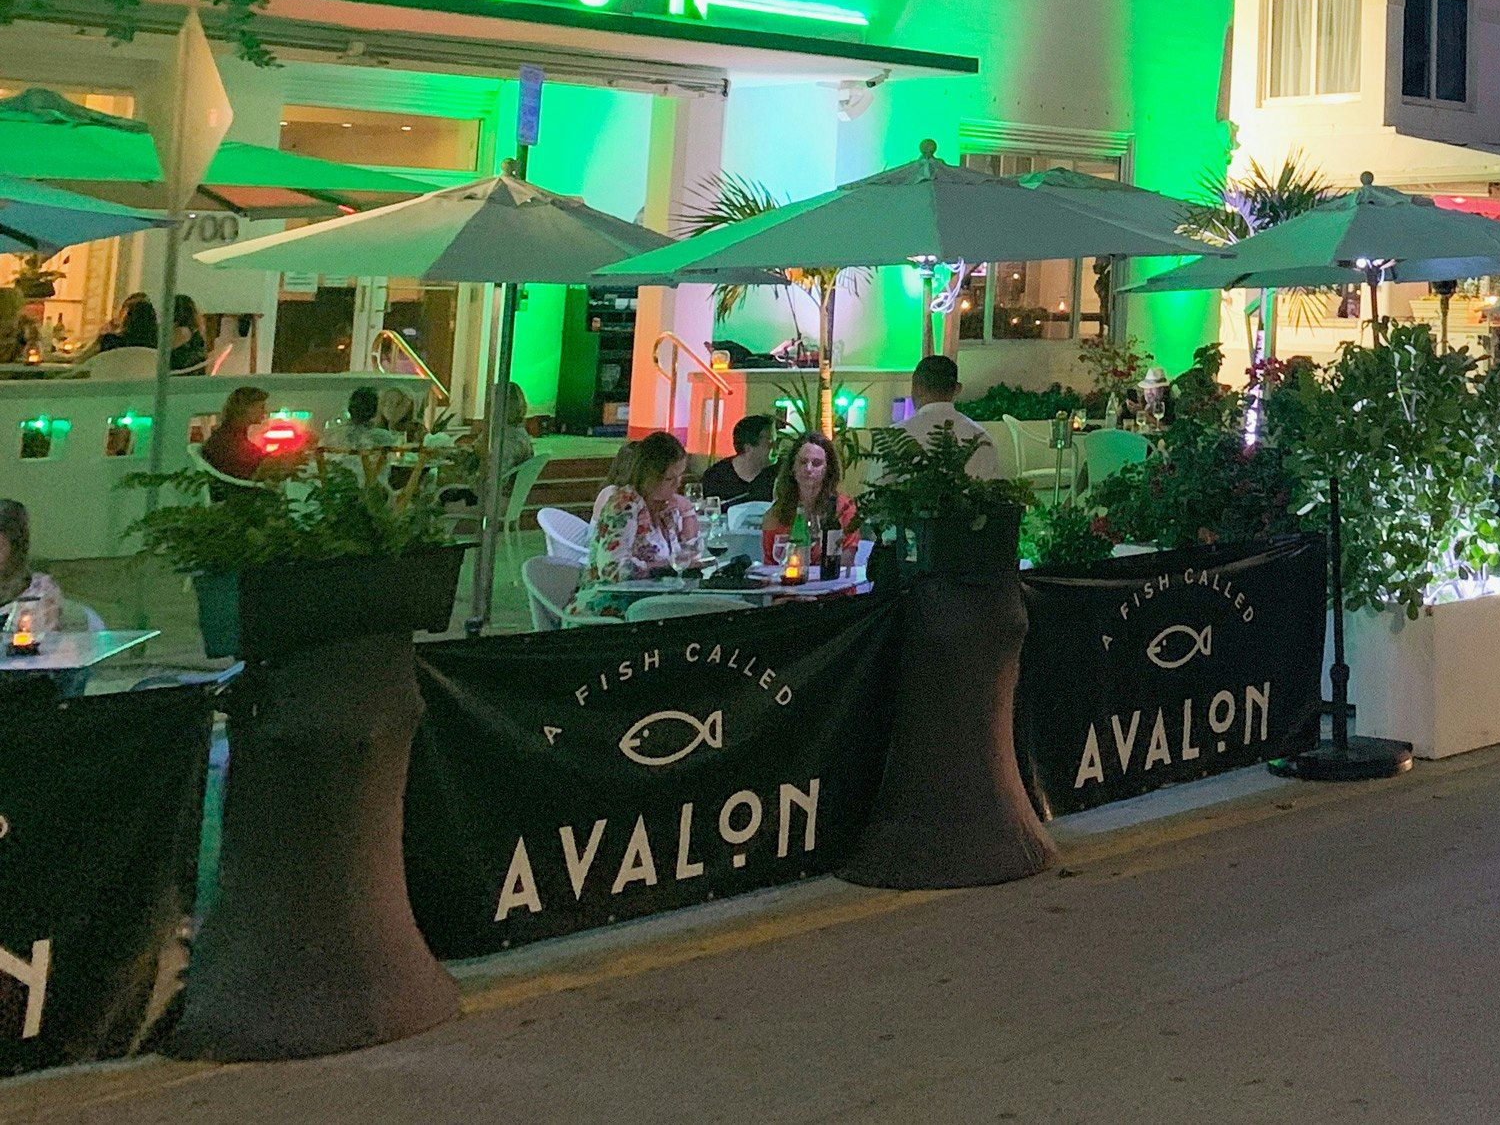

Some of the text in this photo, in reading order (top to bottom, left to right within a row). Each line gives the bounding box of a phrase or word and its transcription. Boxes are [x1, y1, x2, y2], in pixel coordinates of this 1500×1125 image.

[1102, 567, 1254, 651] A FISH CALLED
[543, 642, 793, 745] A FISH CALLED
[1074, 681, 1271, 789] AVALON
[493, 778, 820, 922] AVALON
